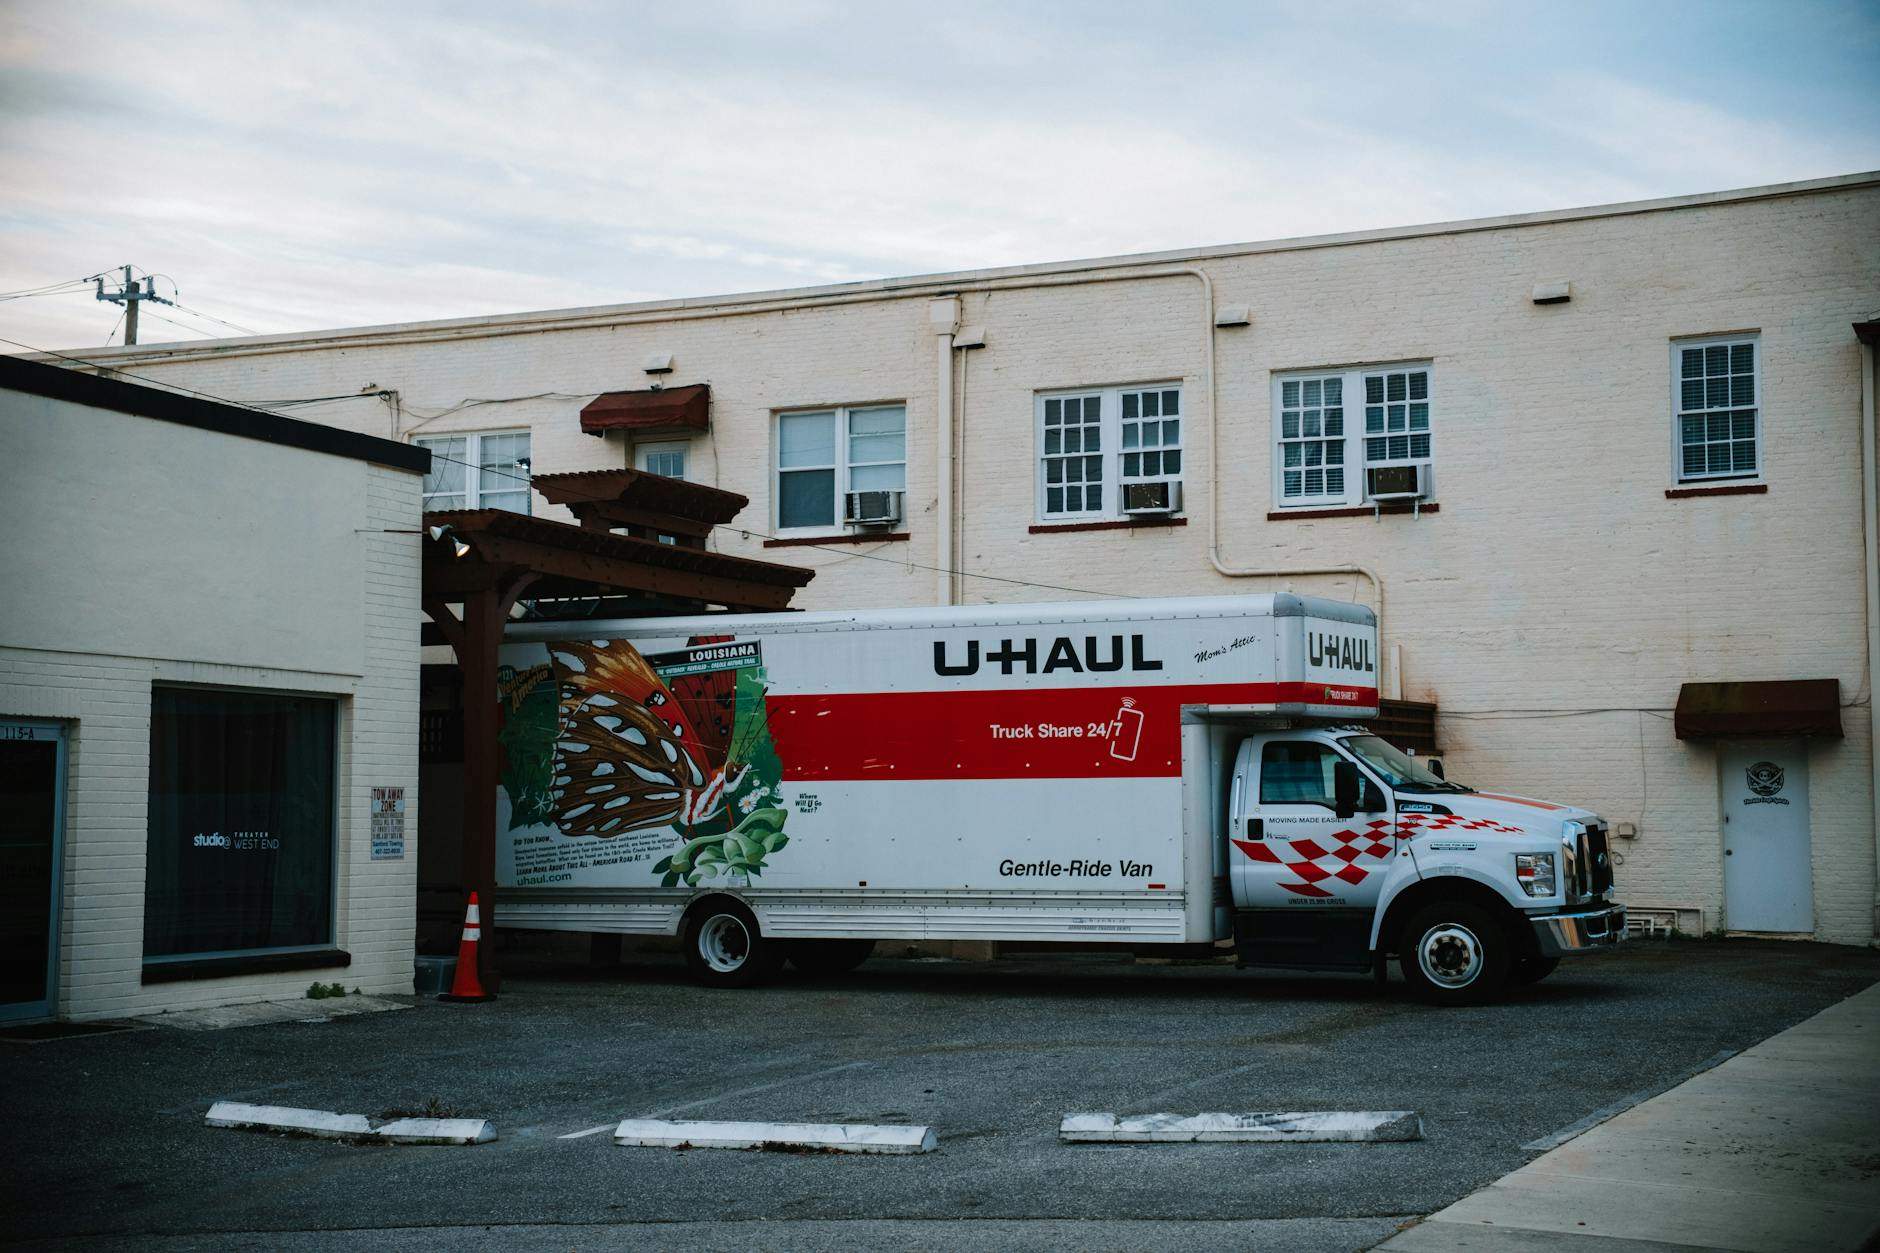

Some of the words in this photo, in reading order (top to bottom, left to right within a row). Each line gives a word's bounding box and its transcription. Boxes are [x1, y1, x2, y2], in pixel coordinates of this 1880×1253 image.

[690, 644, 755, 662] LOUISIANA
[934, 635, 1163, 676] U-HAUL
[1194, 645, 1227, 663] Mom's
[1230, 636, 1256, 651] Attic
[1309, 632, 1374, 672] U-HAUL
[6, 727, 34, 740] 115-A
[990, 723, 1034, 739] Truck
[1038, 722, 1083, 738] Share
[1087, 720, 1123, 740] 24/7
[373, 788, 386, 800] TOW
[388, 788, 404, 800] AWAY
[380, 800, 396, 813] ZONE
[234, 838, 258, 850] WEST
[261, 838, 280, 849] END
[1000, 859, 1112, 877] Gentle-Ride
[1119, 860, 1153, 877] Van
[517, 873, 572, 886] uhaul.com
